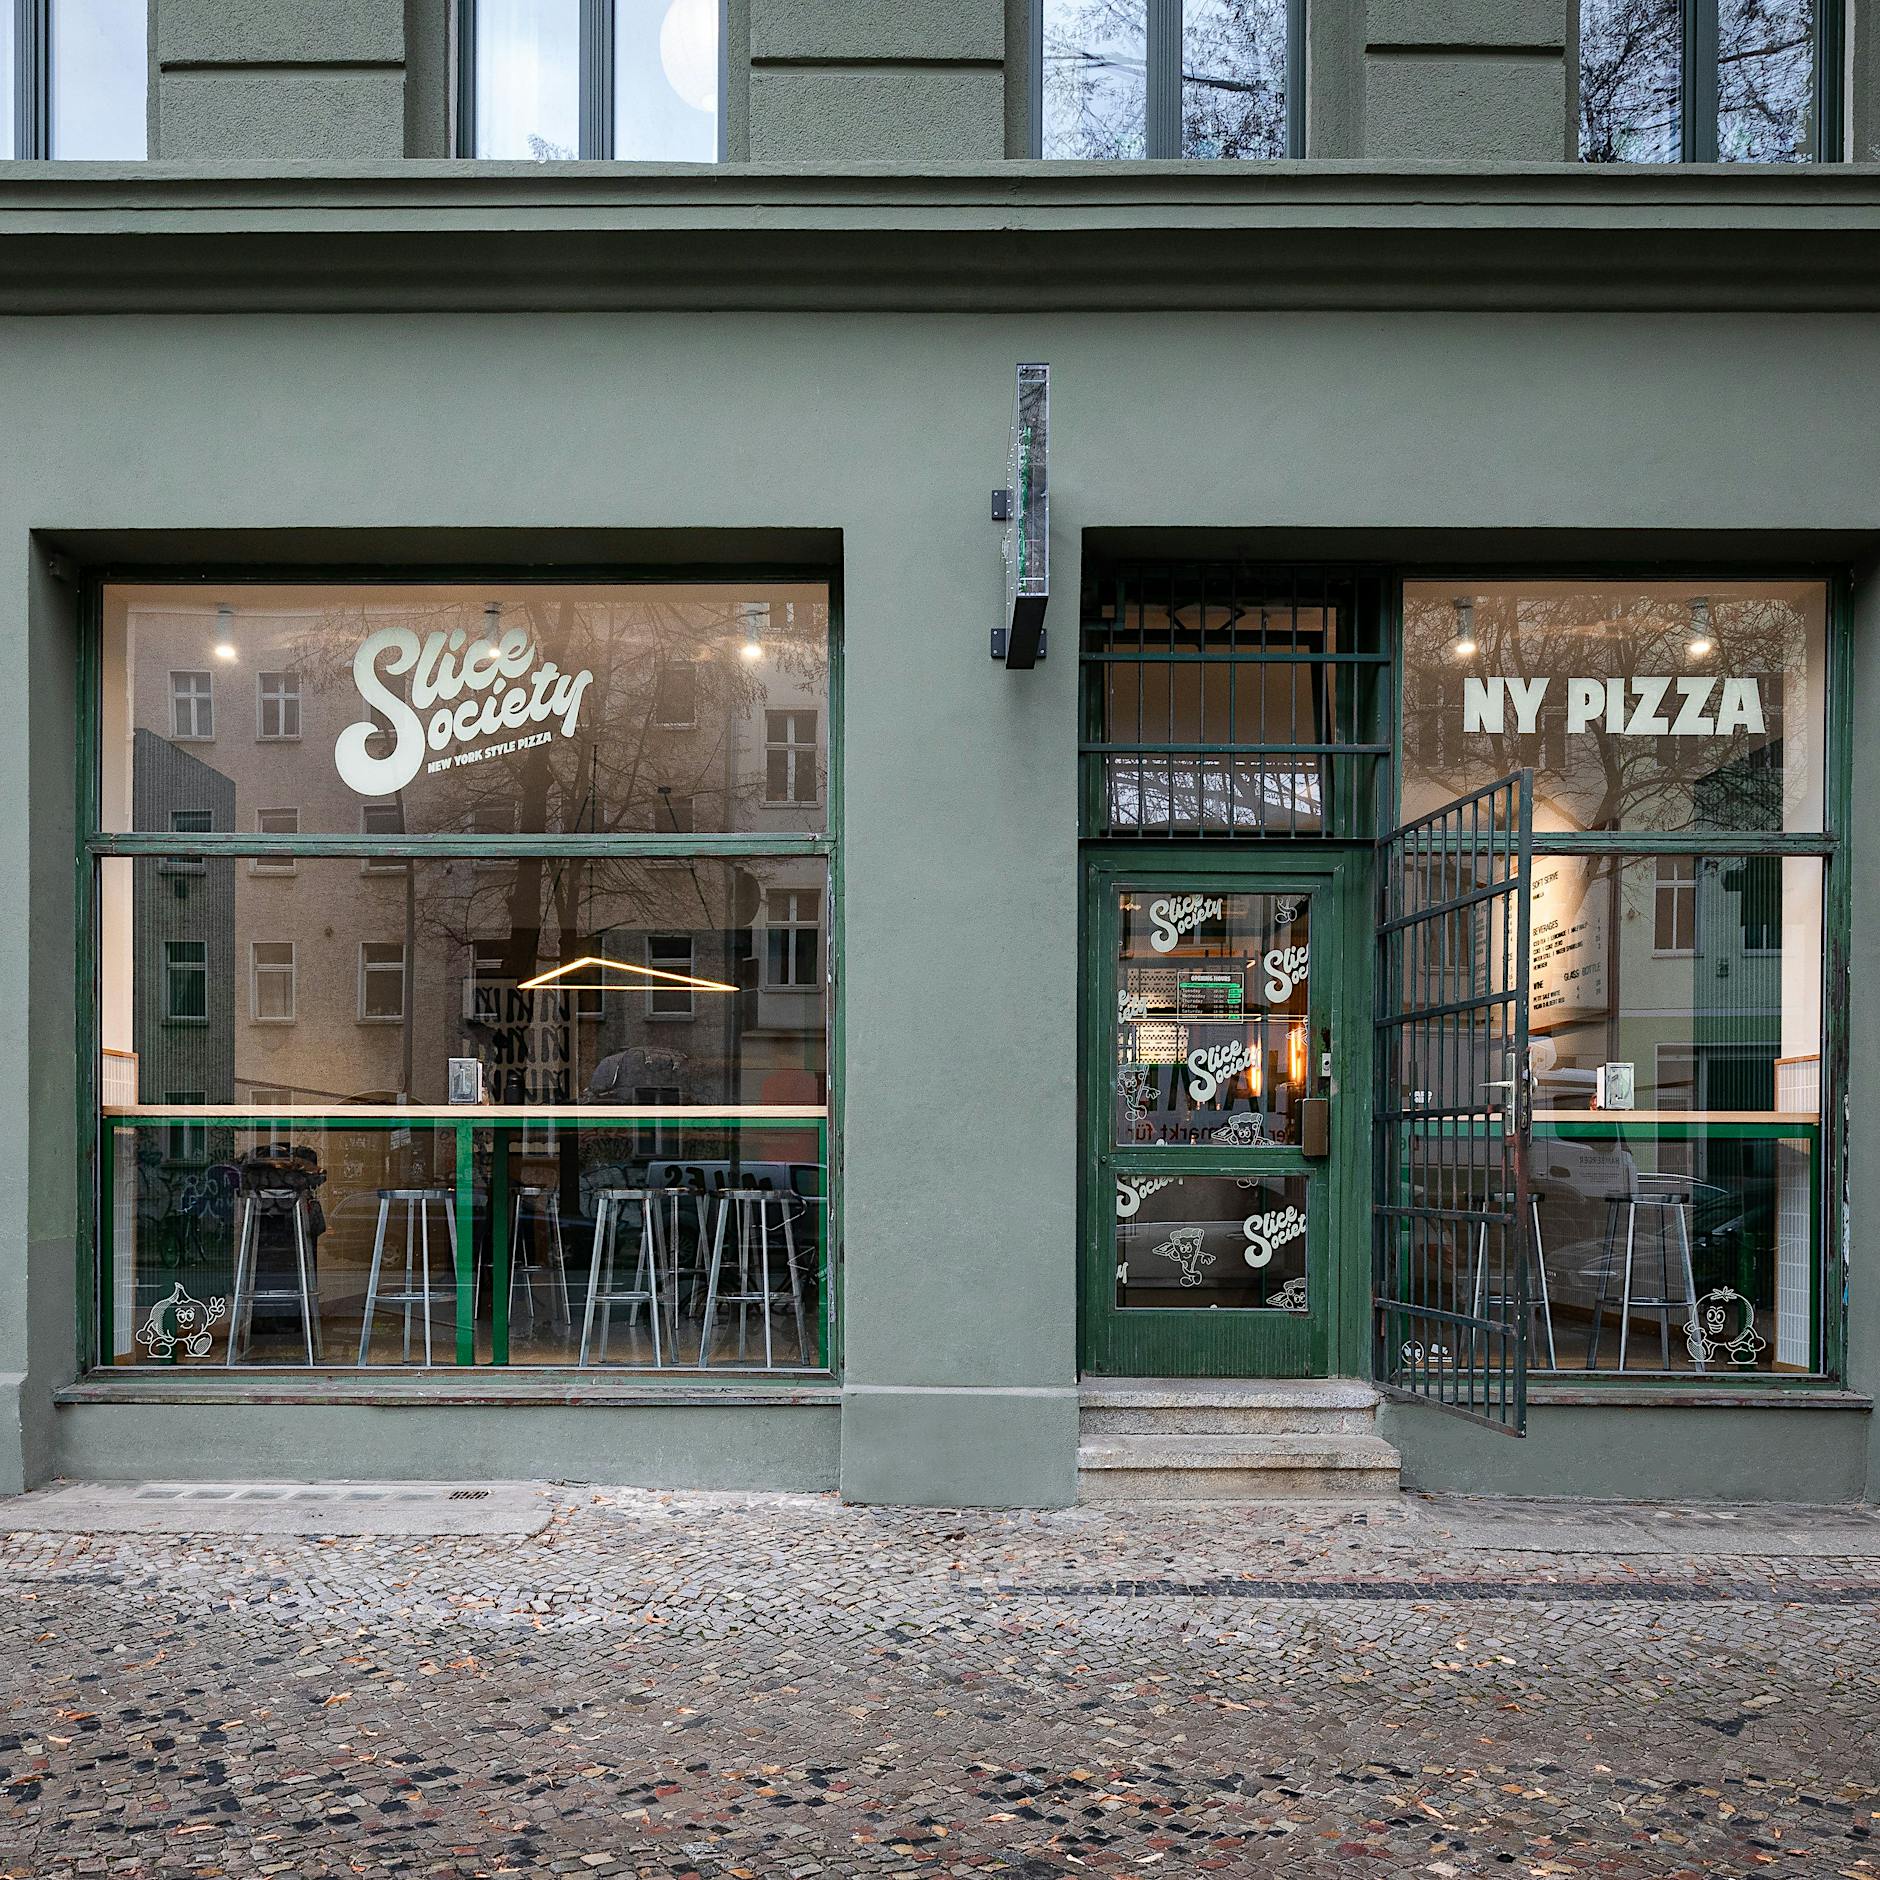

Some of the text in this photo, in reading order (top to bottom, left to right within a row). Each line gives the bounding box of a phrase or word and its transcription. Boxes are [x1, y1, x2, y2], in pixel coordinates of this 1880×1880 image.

[335, 627, 536, 796] Slice
[1463, 676, 1767, 735] NY PIZZA
[427, 731, 553, 774] NEW YORK STYLE PIZZA
[1150, 894, 1205, 952] Slice
[1264, 943, 1309, 1003] Slic
[1564, 962, 1601, 981] GLASS BOTTLE
[1188, 1040, 1242, 1102] Slice
[1243, 1205, 1297, 1268] Slice
